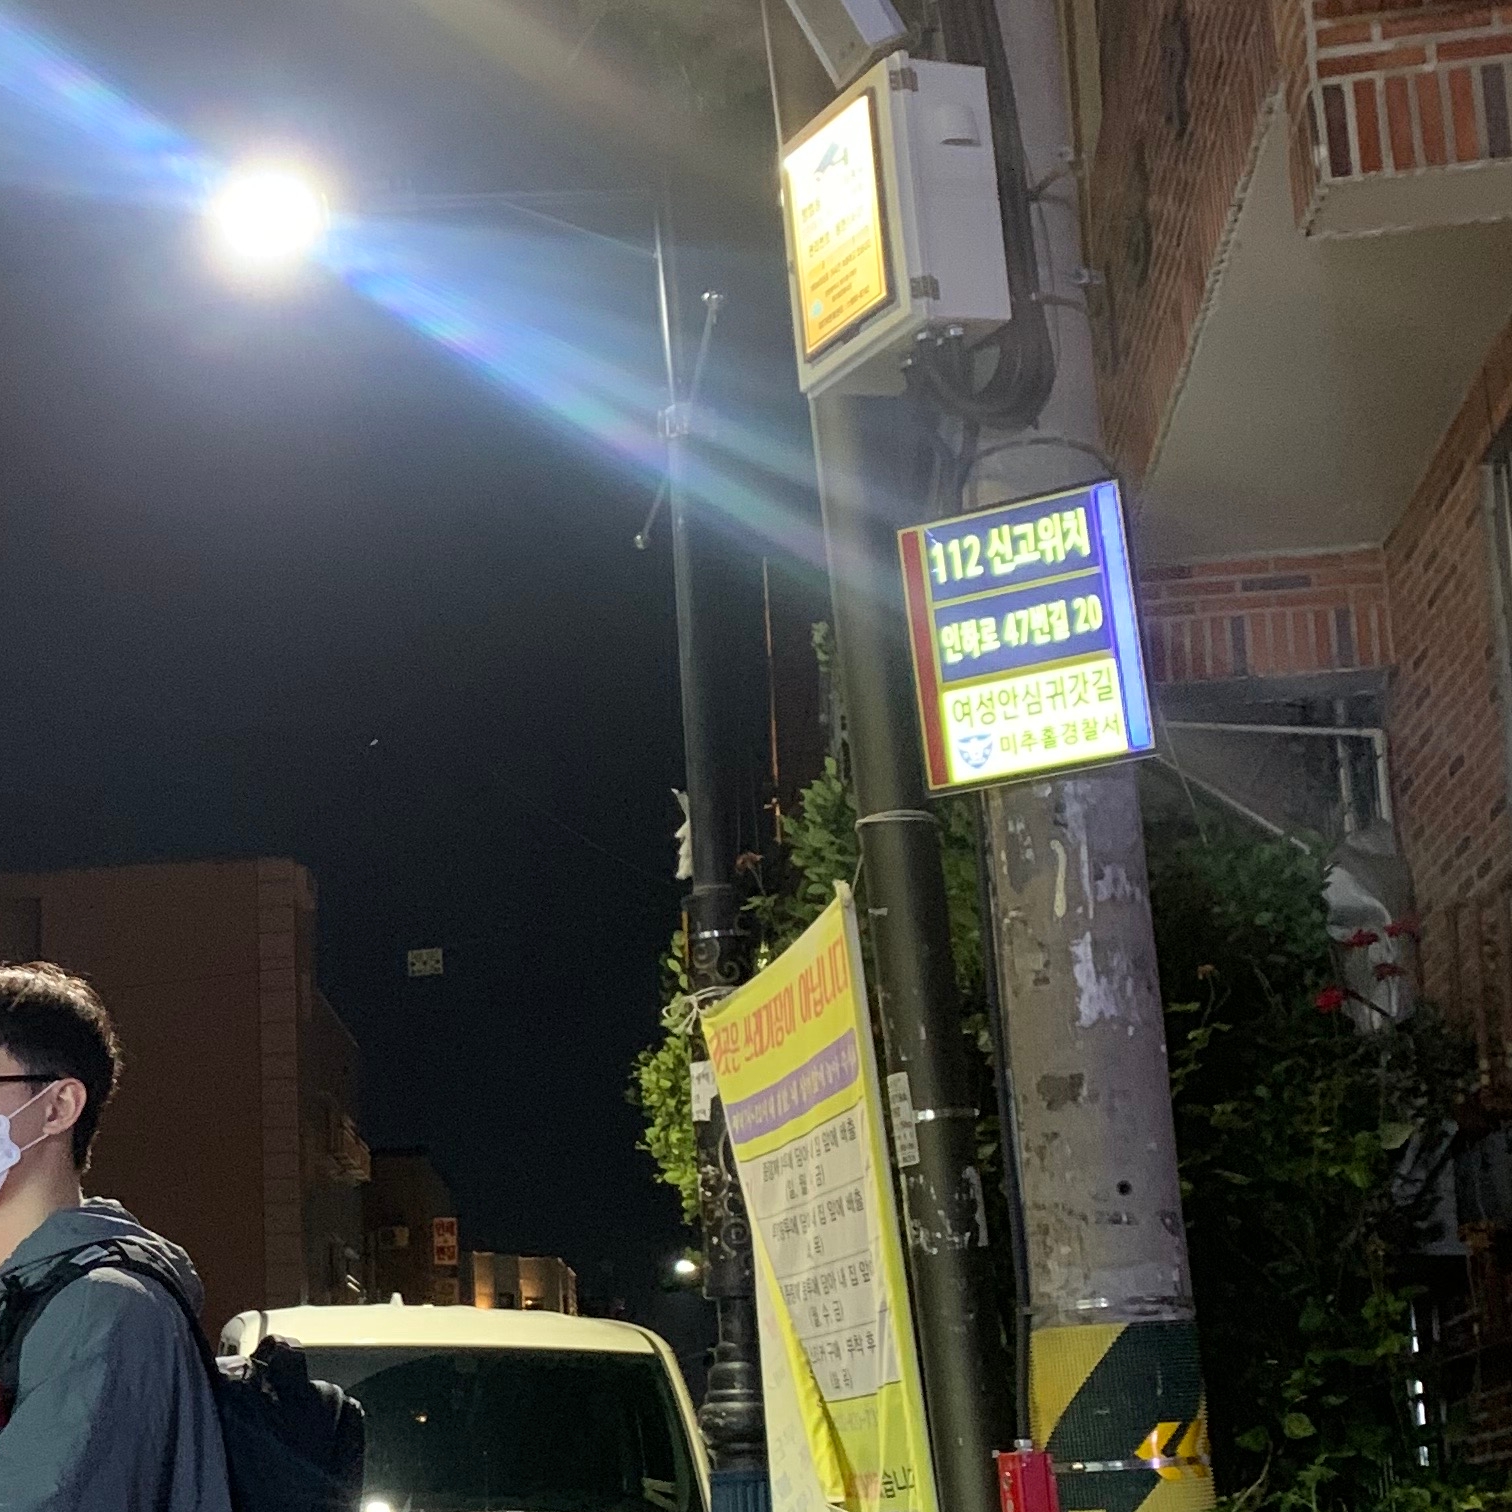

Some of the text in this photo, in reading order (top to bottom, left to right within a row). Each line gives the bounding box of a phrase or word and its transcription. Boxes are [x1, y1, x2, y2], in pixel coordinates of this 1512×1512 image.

[930, 507, 1091, 584] 112 신고위치
[940, 594, 1104, 665] 인하로 47번길 20
[951, 667, 1115, 729] 여성안심귀갓길
[999, 713, 1122, 756] 미추홀경찰서
[799, 935, 849, 1024] 아닙니다
